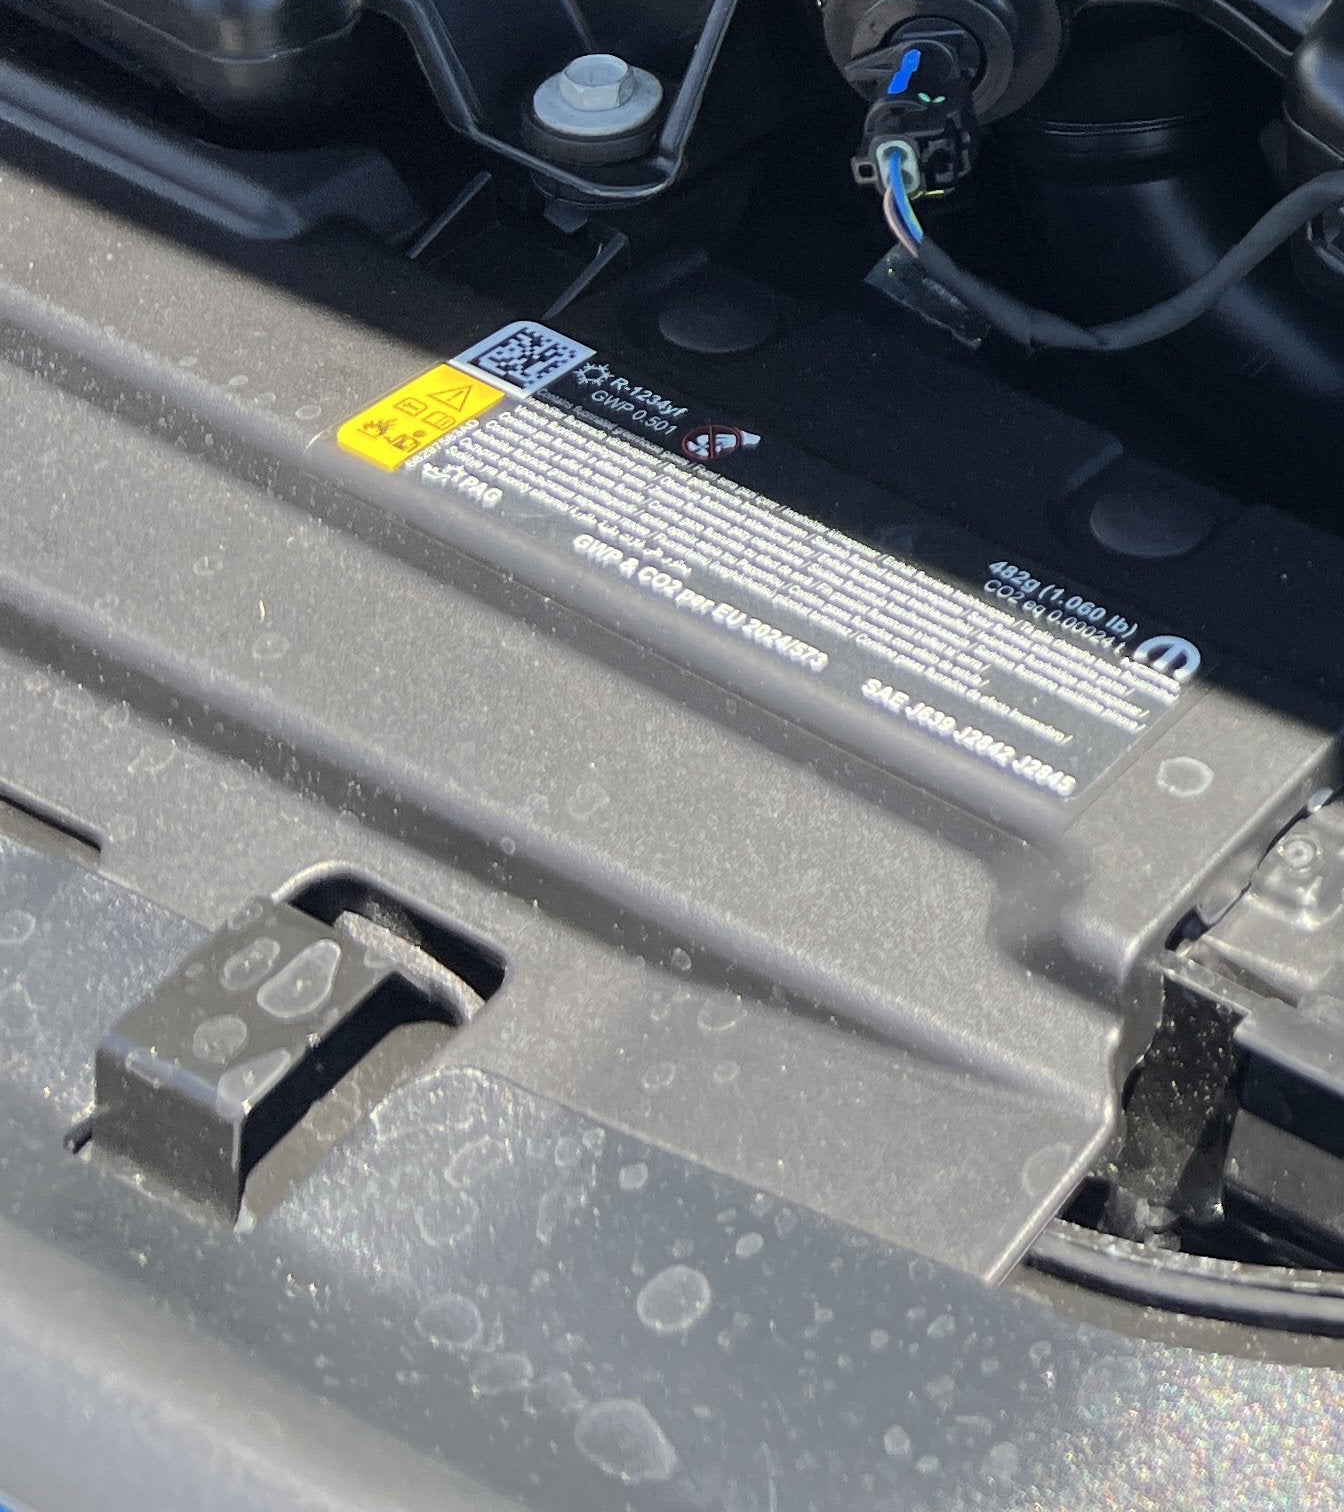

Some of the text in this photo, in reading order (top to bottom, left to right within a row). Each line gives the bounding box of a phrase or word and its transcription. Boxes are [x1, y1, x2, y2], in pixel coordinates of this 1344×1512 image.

[590, 389, 678, 435] GWP 0.501
[609, 378, 688, 418] R-1234yf
[457, 475, 503, 508] PAG
[573, 533, 623, 567] GWP
[620, 557, 640, 578] &
[638, 566, 683, 597] CO2
[676, 588, 715, 615] per
[712, 602, 747, 629] EU
[742, 618, 829, 668] 2024/573
[984, 579, 1026, 604] CO2
[1022, 600, 1046, 618] eq
[1047, 610, 1115, 648] 0.00024
[988, 561, 1139, 638] 482g (1.060 lb)
[861, 678, 1077, 796] SAE J639 J2842 J2845
